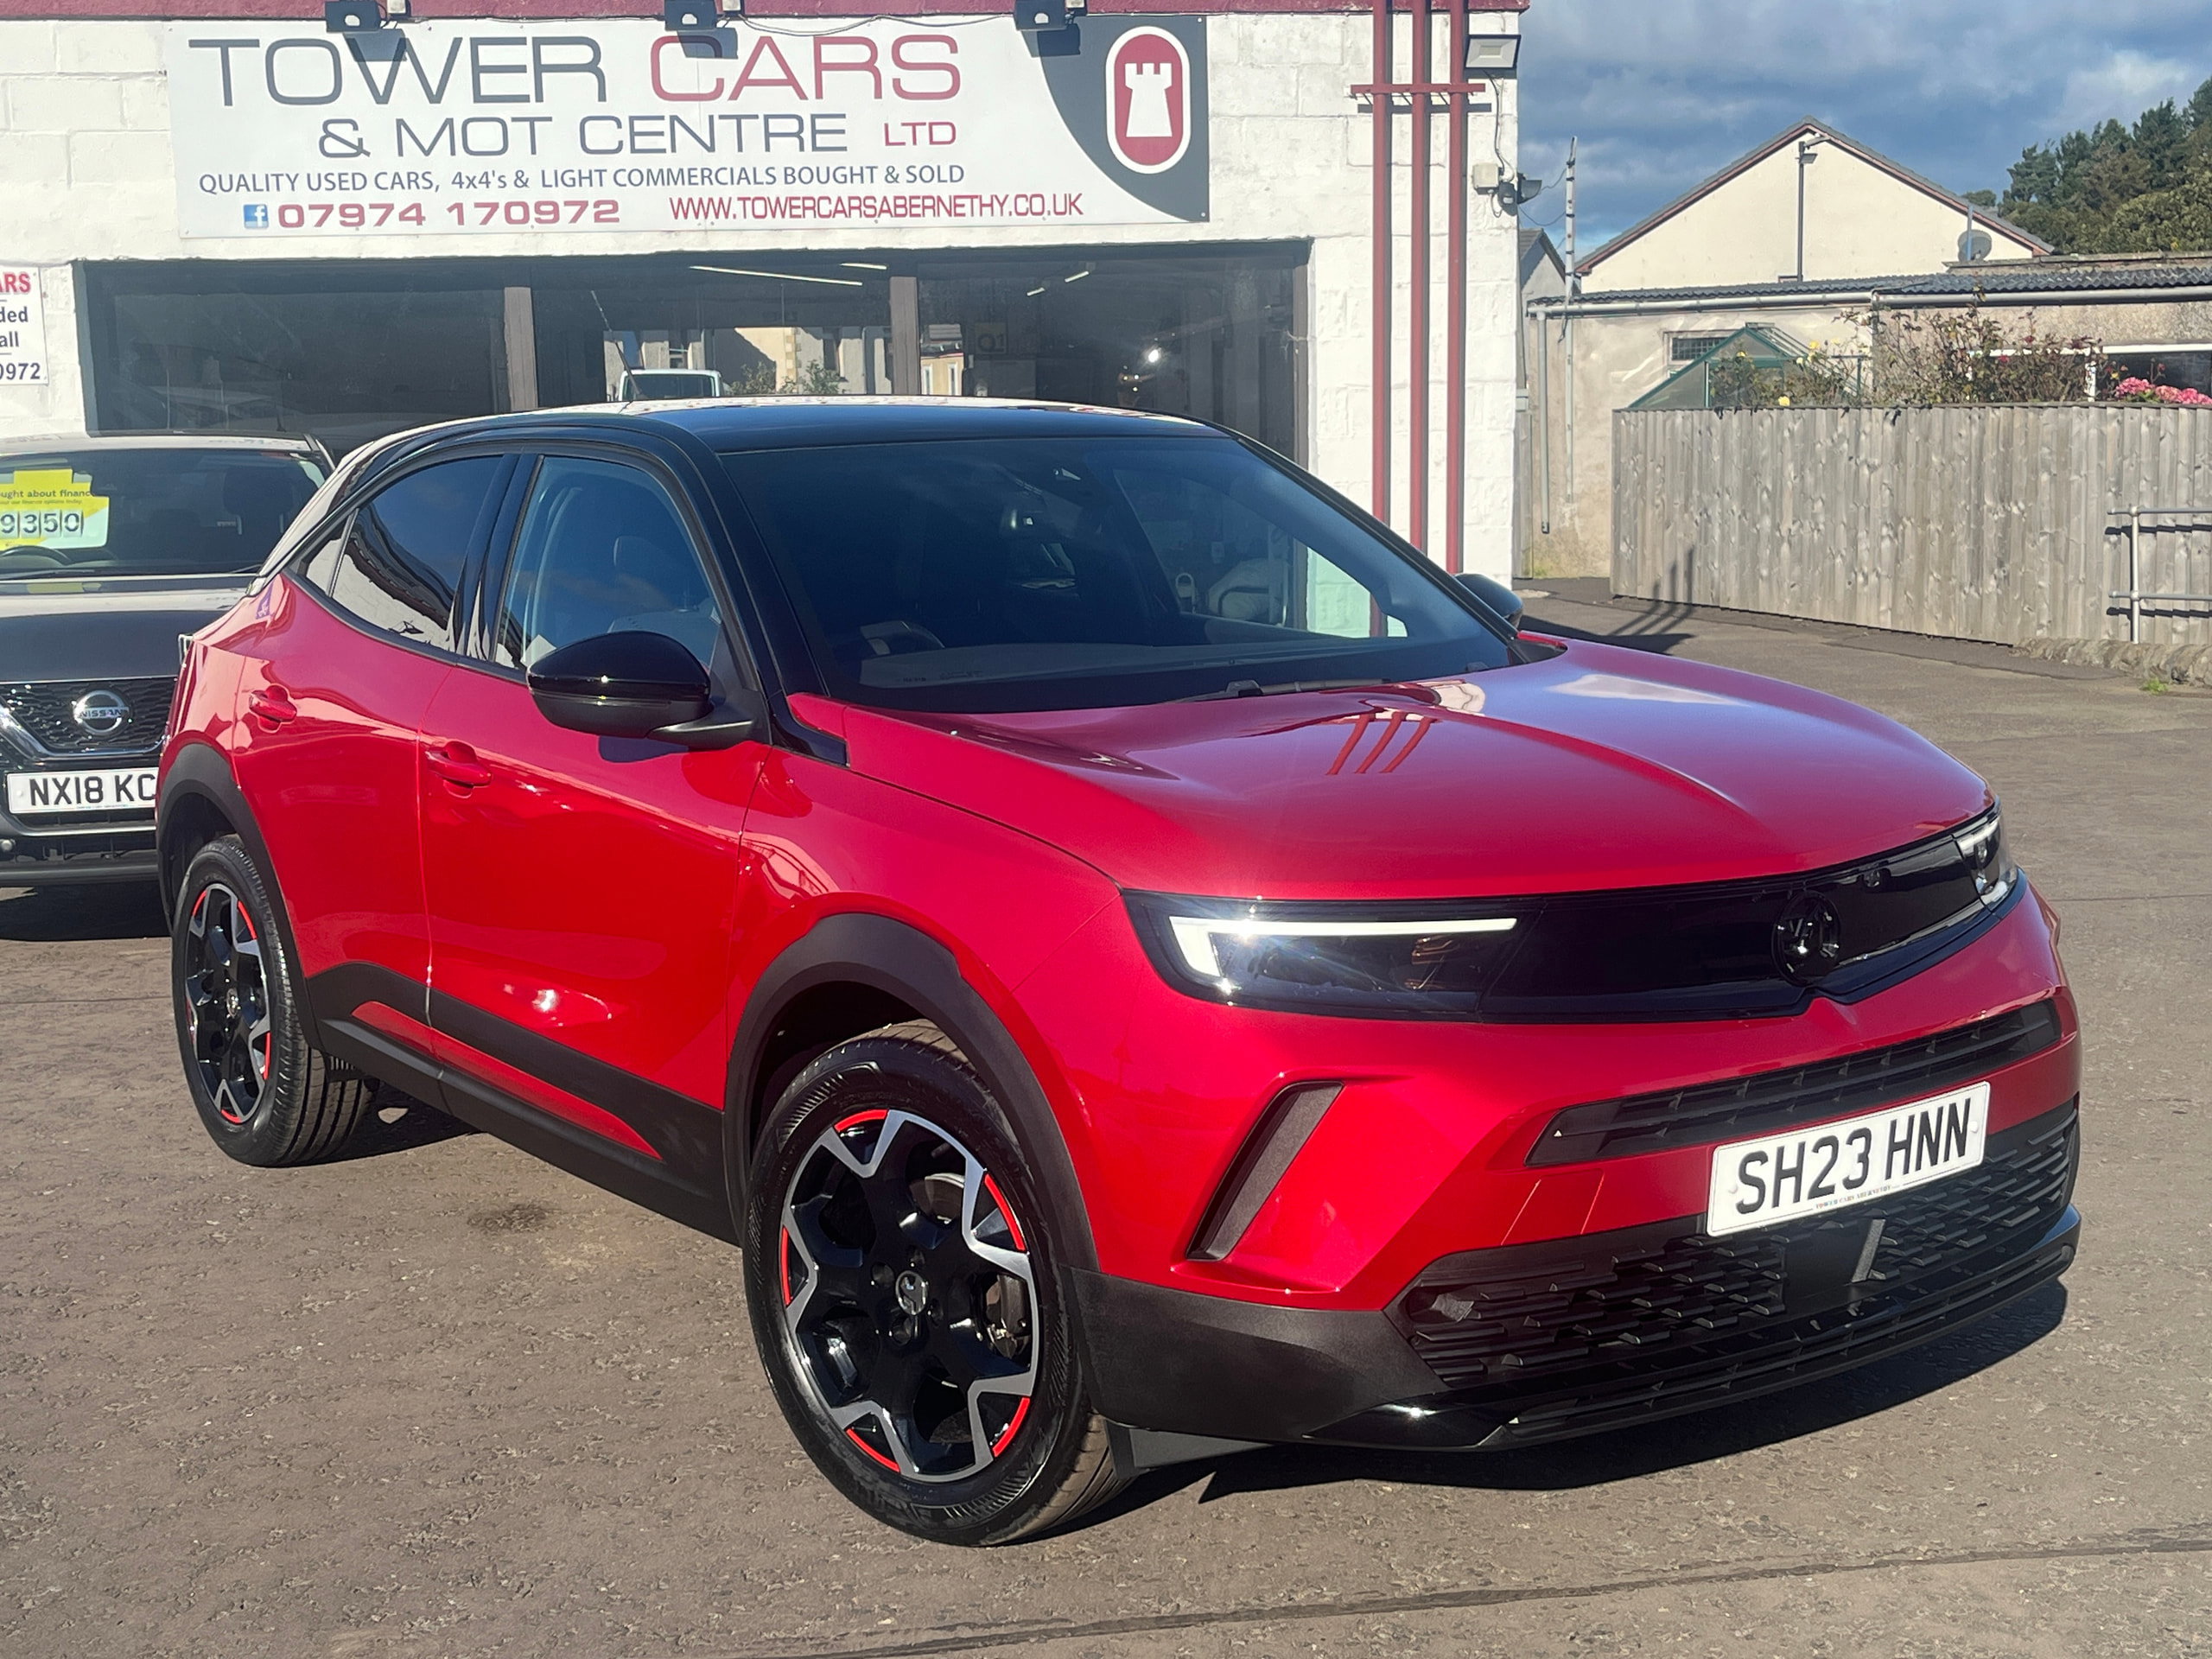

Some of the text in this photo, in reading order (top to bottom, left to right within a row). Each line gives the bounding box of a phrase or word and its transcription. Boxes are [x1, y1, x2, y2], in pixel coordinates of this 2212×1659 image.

[188, 35, 961, 105] TOWER CARS
[318, 113, 957, 157] & MOT CENTRE LTD
[199, 173, 300, 194] QUALITY
[306, 172, 367, 192] USED
[374, 171, 440, 193] CARS,
[513, 169, 529, 188] &
[541, 168, 607, 188] LIGHT
[613, 165, 778, 187] COMMERCIALS
[784, 165, 879, 185] BOUGHT
[884, 165, 900, 184] &
[906, 164, 965, 183] SOLD
[277, 203, 426, 228] 07974
[446, 200, 620, 226] 170972
[669, 193, 1084, 220] WWW.TOWERCARSABERNETHY.CO.UK
[0, 272, 31, 294] RS
[27, 489, 56, 498] about
[81, 709, 122, 718] NISSAN
[29, 776, 104, 806] NX18
[1736, 1097, 1971, 1215] SH23 HNN
